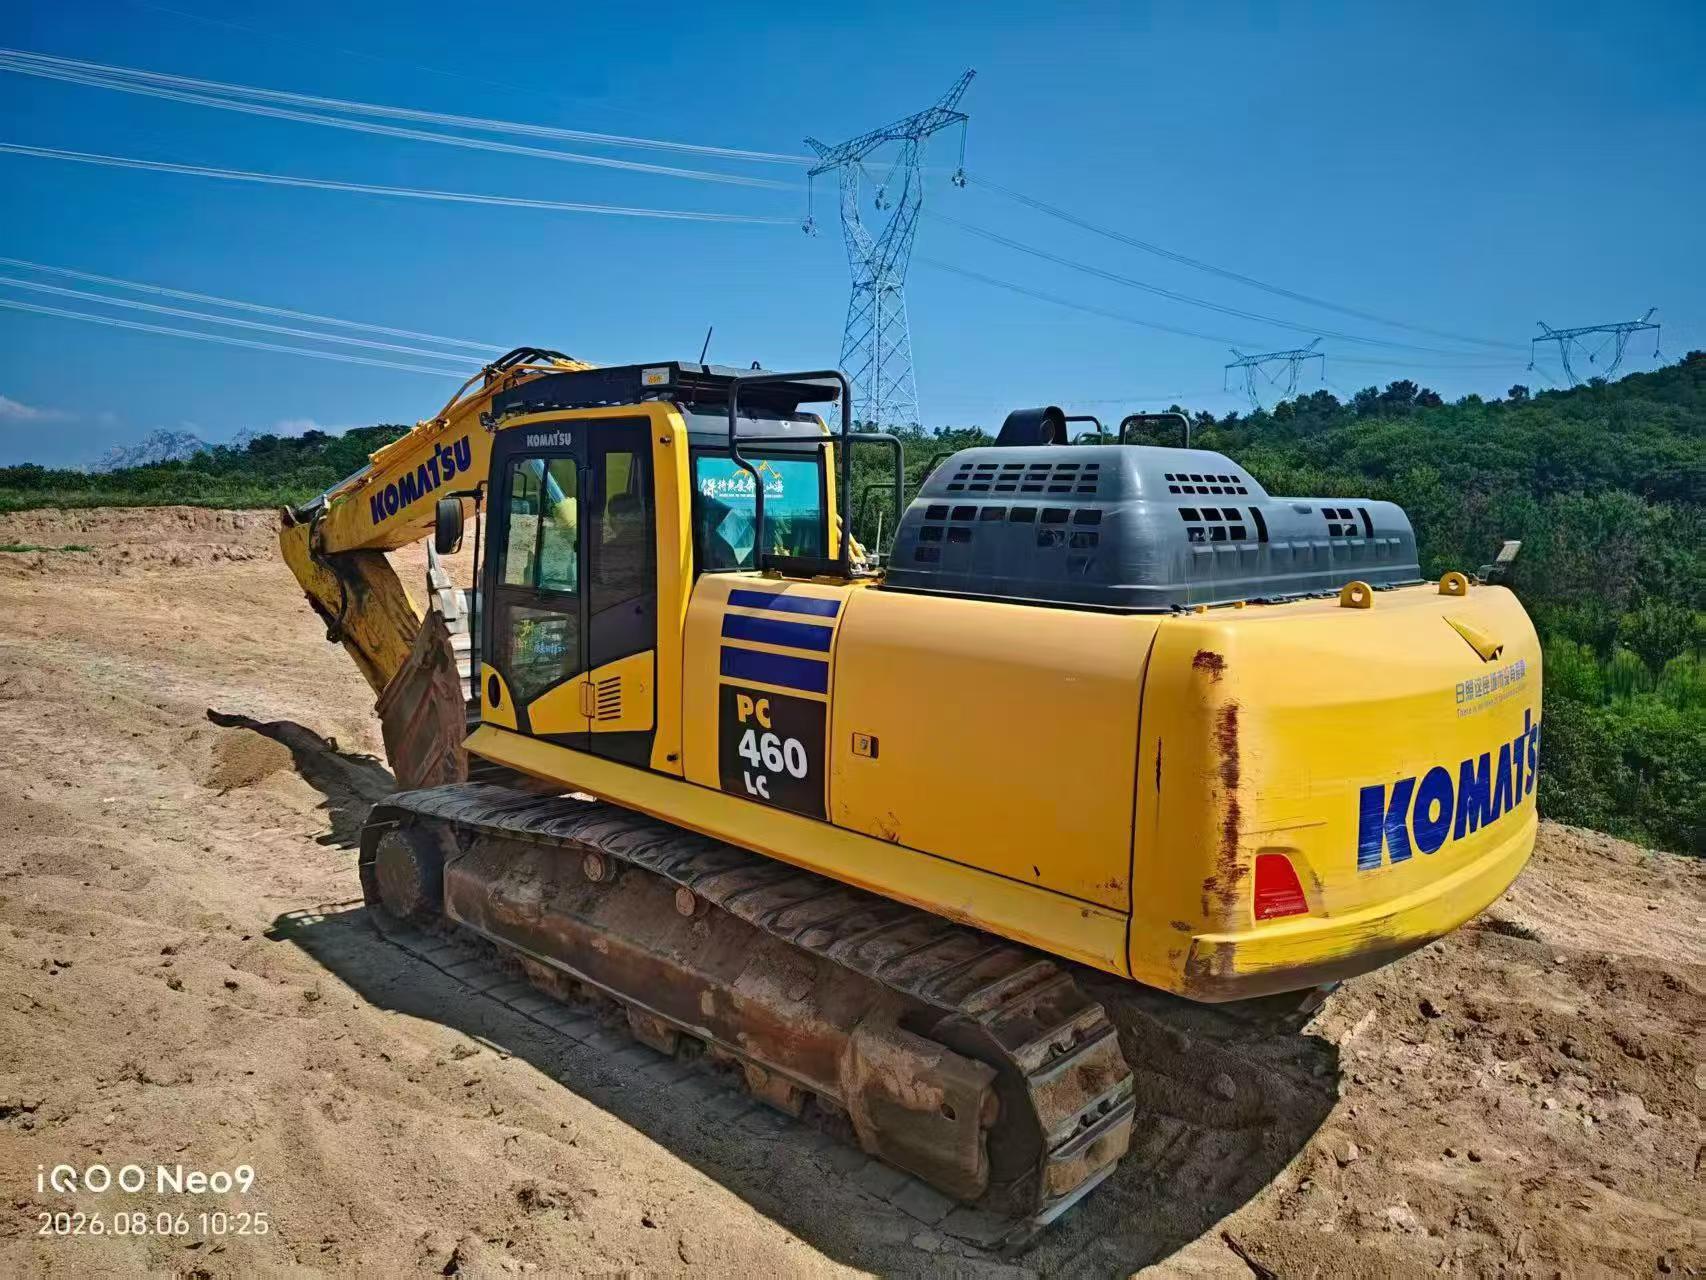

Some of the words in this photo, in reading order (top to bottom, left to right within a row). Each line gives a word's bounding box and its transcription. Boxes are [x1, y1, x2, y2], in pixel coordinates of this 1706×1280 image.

[527, 429, 571, 447] KOMATSU
[370, 435, 471, 526] KOMATSU
[736, 694, 772, 729] PC
[738, 729, 808, 779] 460
[743, 771, 770, 799] LC
[1357, 708, 1541, 872] KOMATS
